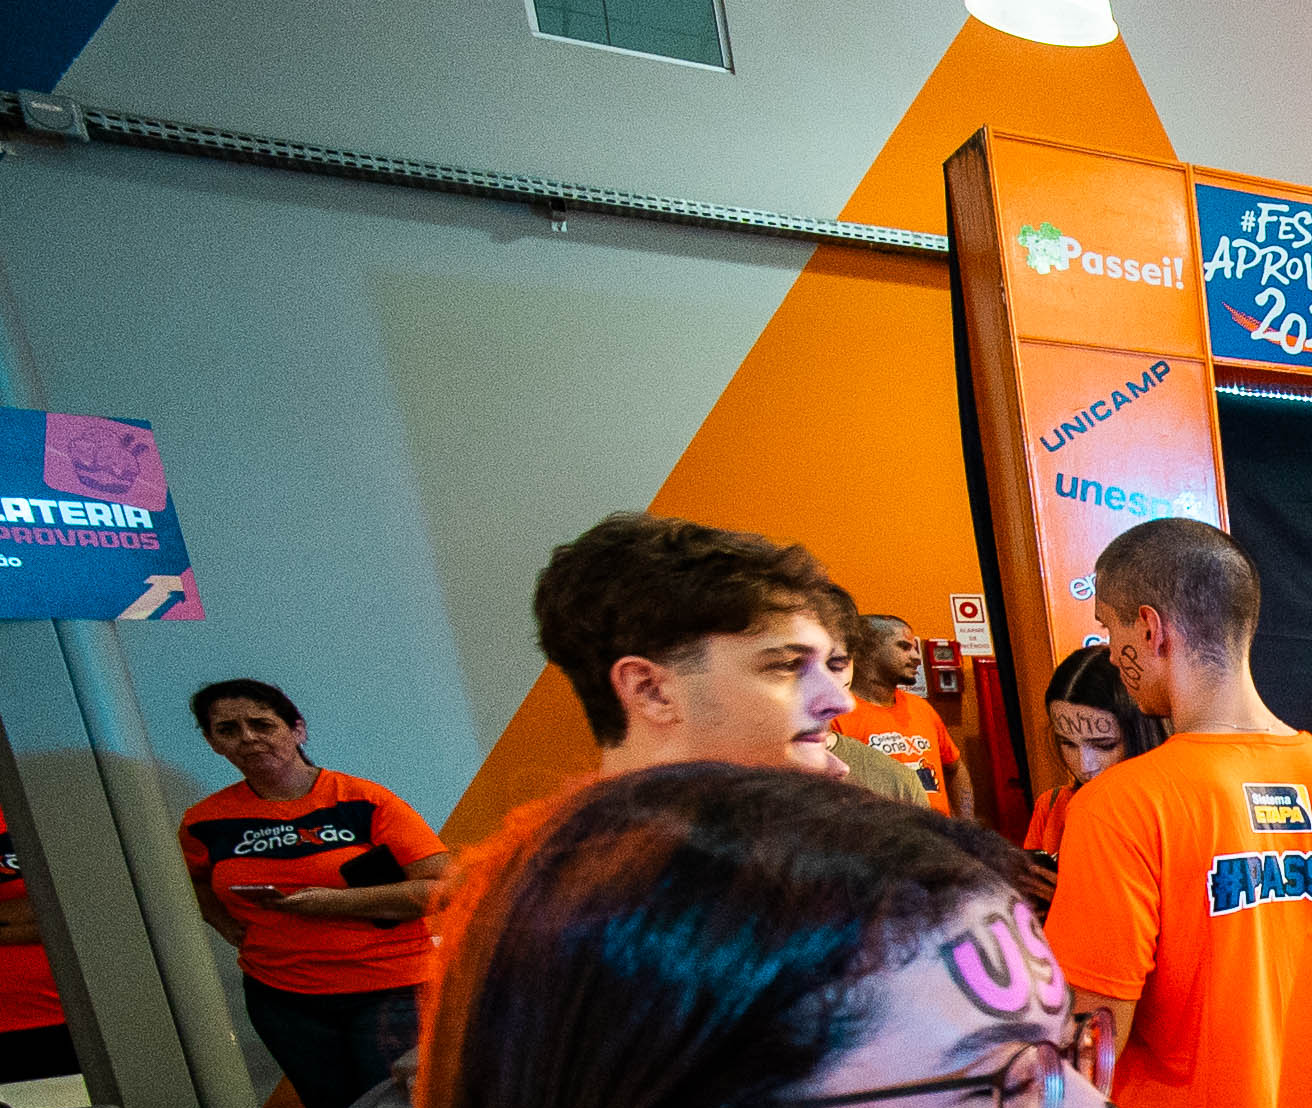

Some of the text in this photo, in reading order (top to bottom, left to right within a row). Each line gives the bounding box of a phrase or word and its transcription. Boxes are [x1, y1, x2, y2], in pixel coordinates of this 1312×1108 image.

[1039, 360, 1171, 452] UNICAMP
[0, 497, 153, 528] ATERIA
[1254, 805, 1305, 824] ETAPA
